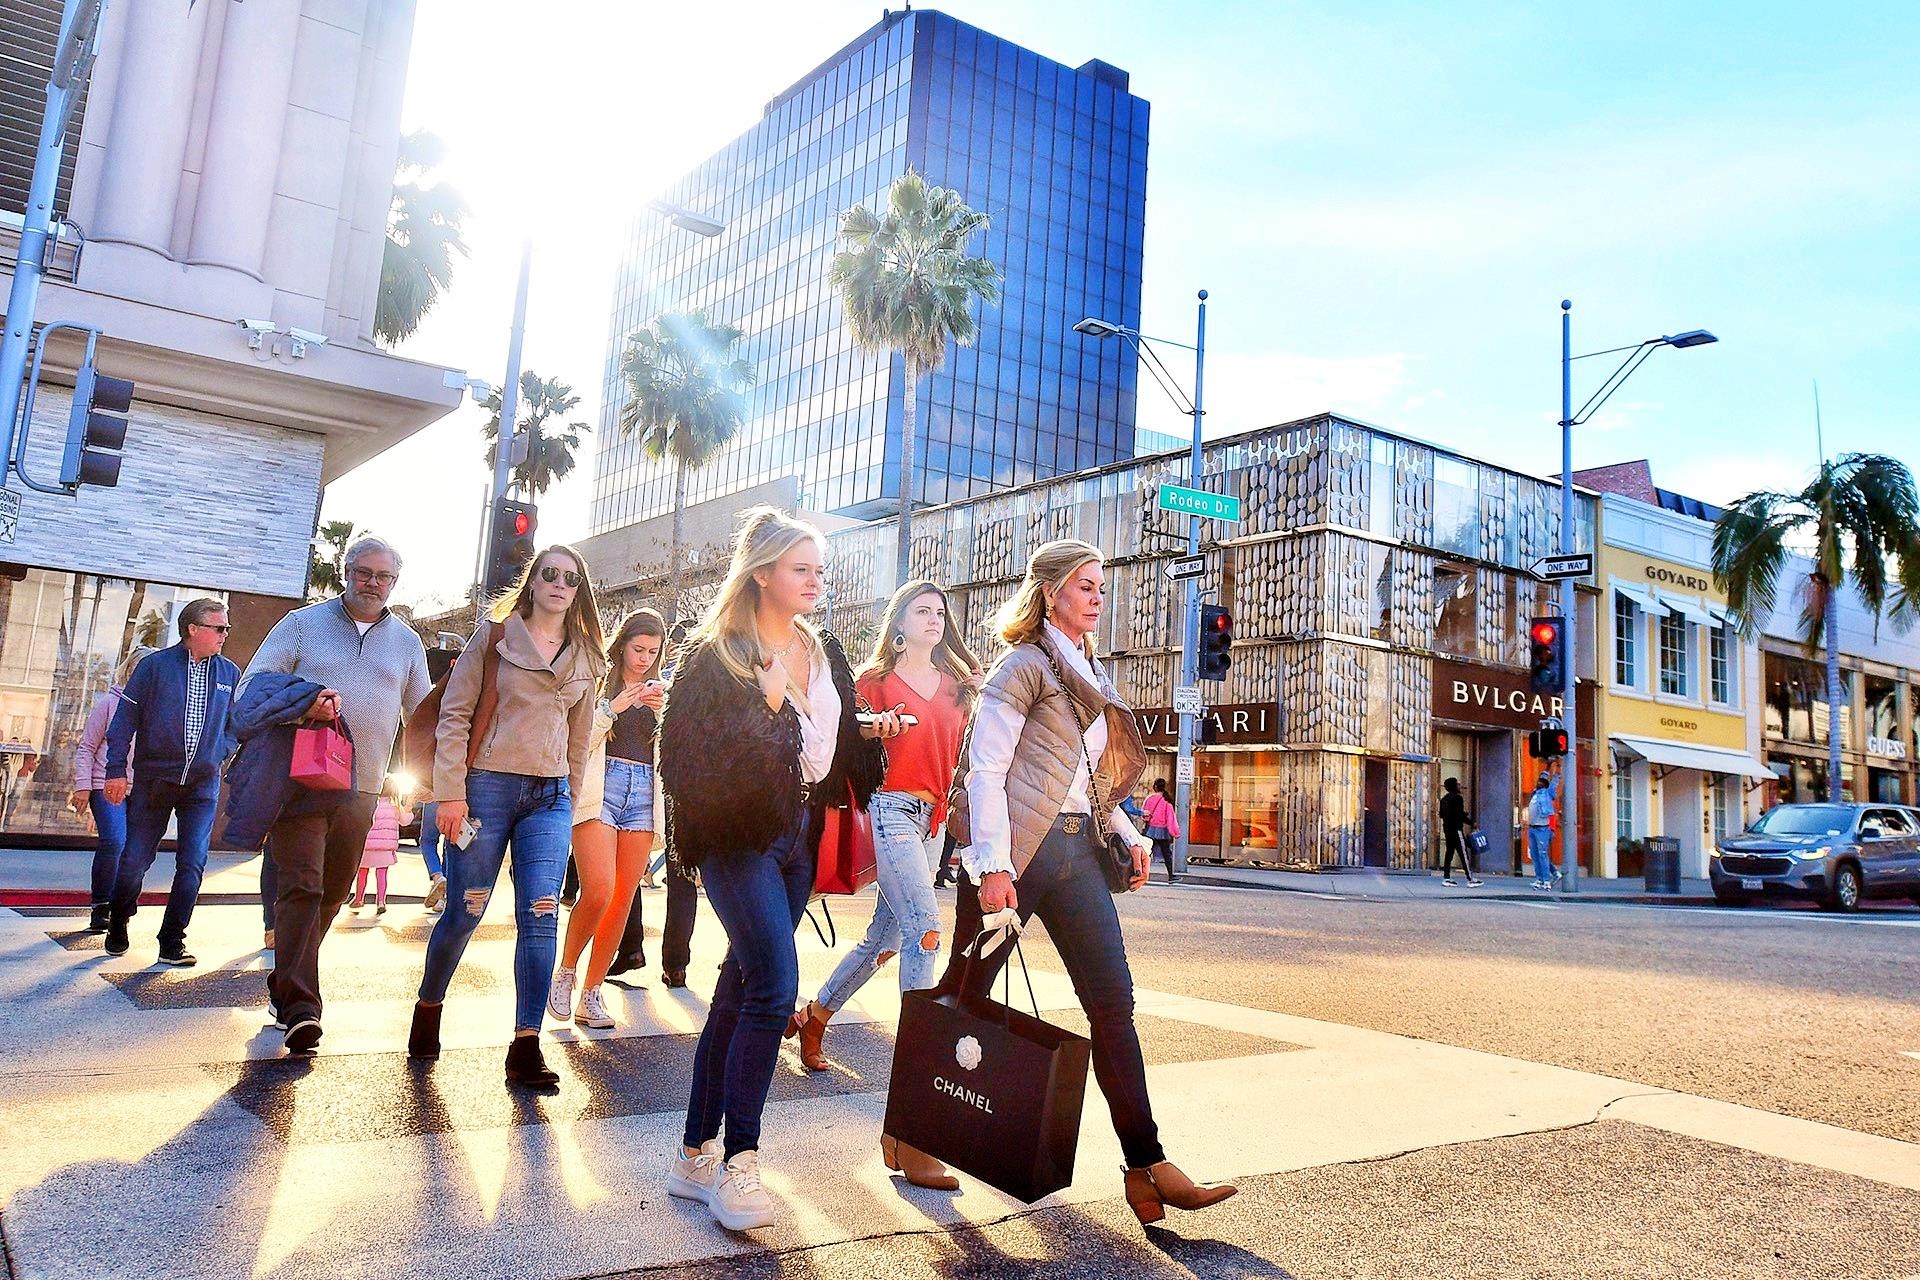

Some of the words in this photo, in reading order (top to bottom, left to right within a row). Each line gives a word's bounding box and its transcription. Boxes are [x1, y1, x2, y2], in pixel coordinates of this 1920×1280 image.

[1169, 492, 1208, 510] Rodeo
[1215, 500, 1229, 514] Dr
[1175, 563, 1187, 573] ONE
[1189, 561, 1200, 570] WAY
[1547, 563, 1564, 572] ONE
[1567, 561, 1584, 570] WAY
[1645, 566, 1708, 591] GOYARD
[1177, 701, 1187, 711] OK
[1453, 680, 1563, 717] BVLGAR
[1143, 709, 1265, 735] VLARI
[1660, 717, 1698, 731] GOYARD
[1867, 735, 1906, 759] GUESS
[933, 1076, 993, 1114] CHANEL
